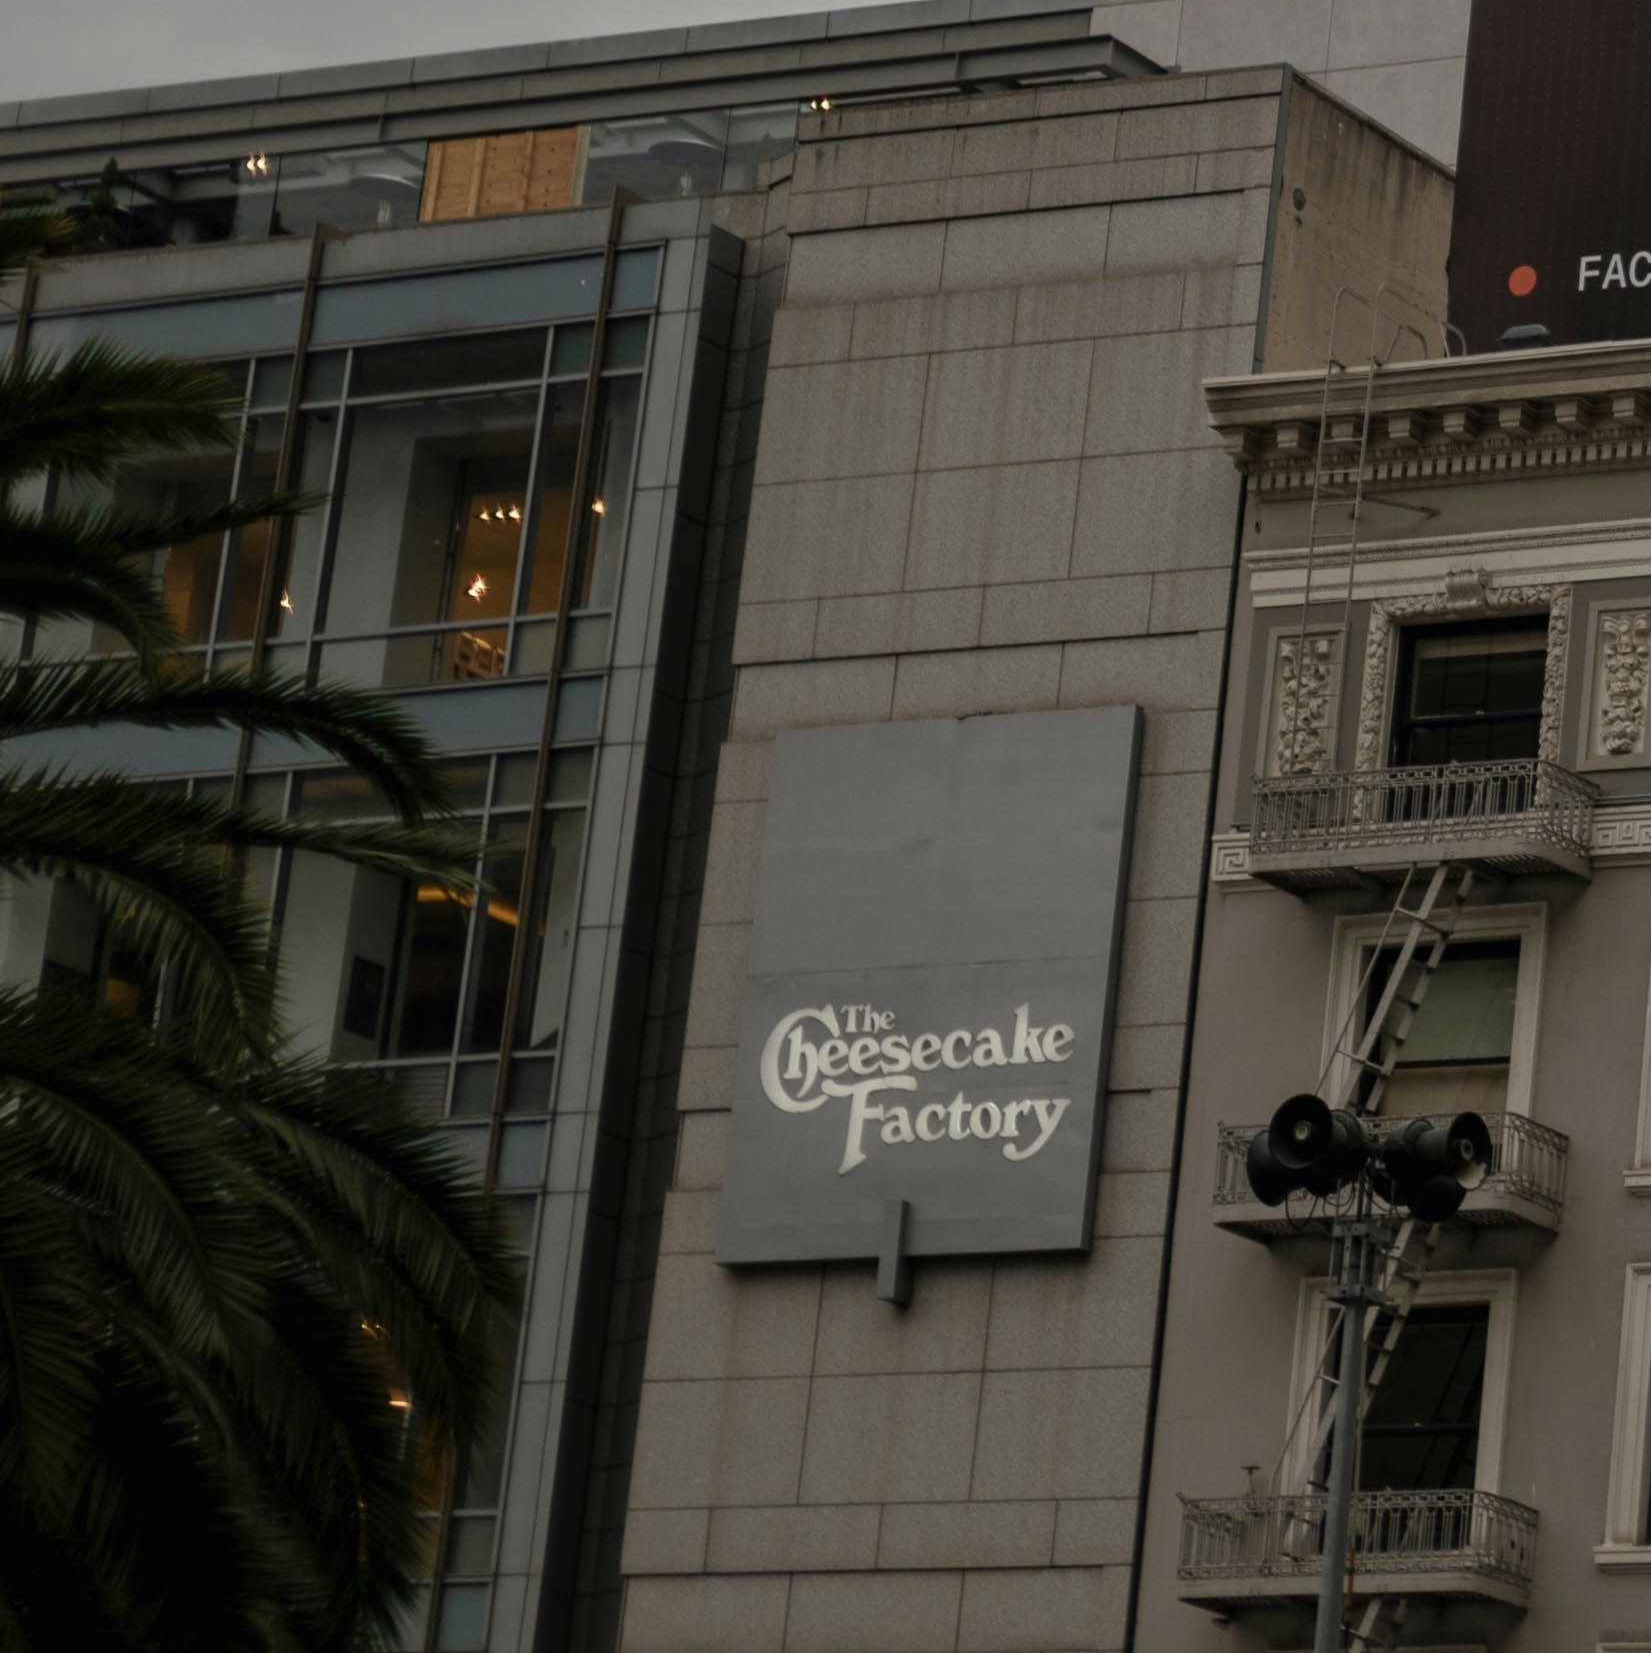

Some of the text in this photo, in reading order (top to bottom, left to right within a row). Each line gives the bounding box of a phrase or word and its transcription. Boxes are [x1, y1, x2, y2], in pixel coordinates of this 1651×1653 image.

[760, 1002, 1076, 1114] Cheesecake
[840, 1003, 896, 1034] The
[821, 1074, 1073, 1176] Factory
